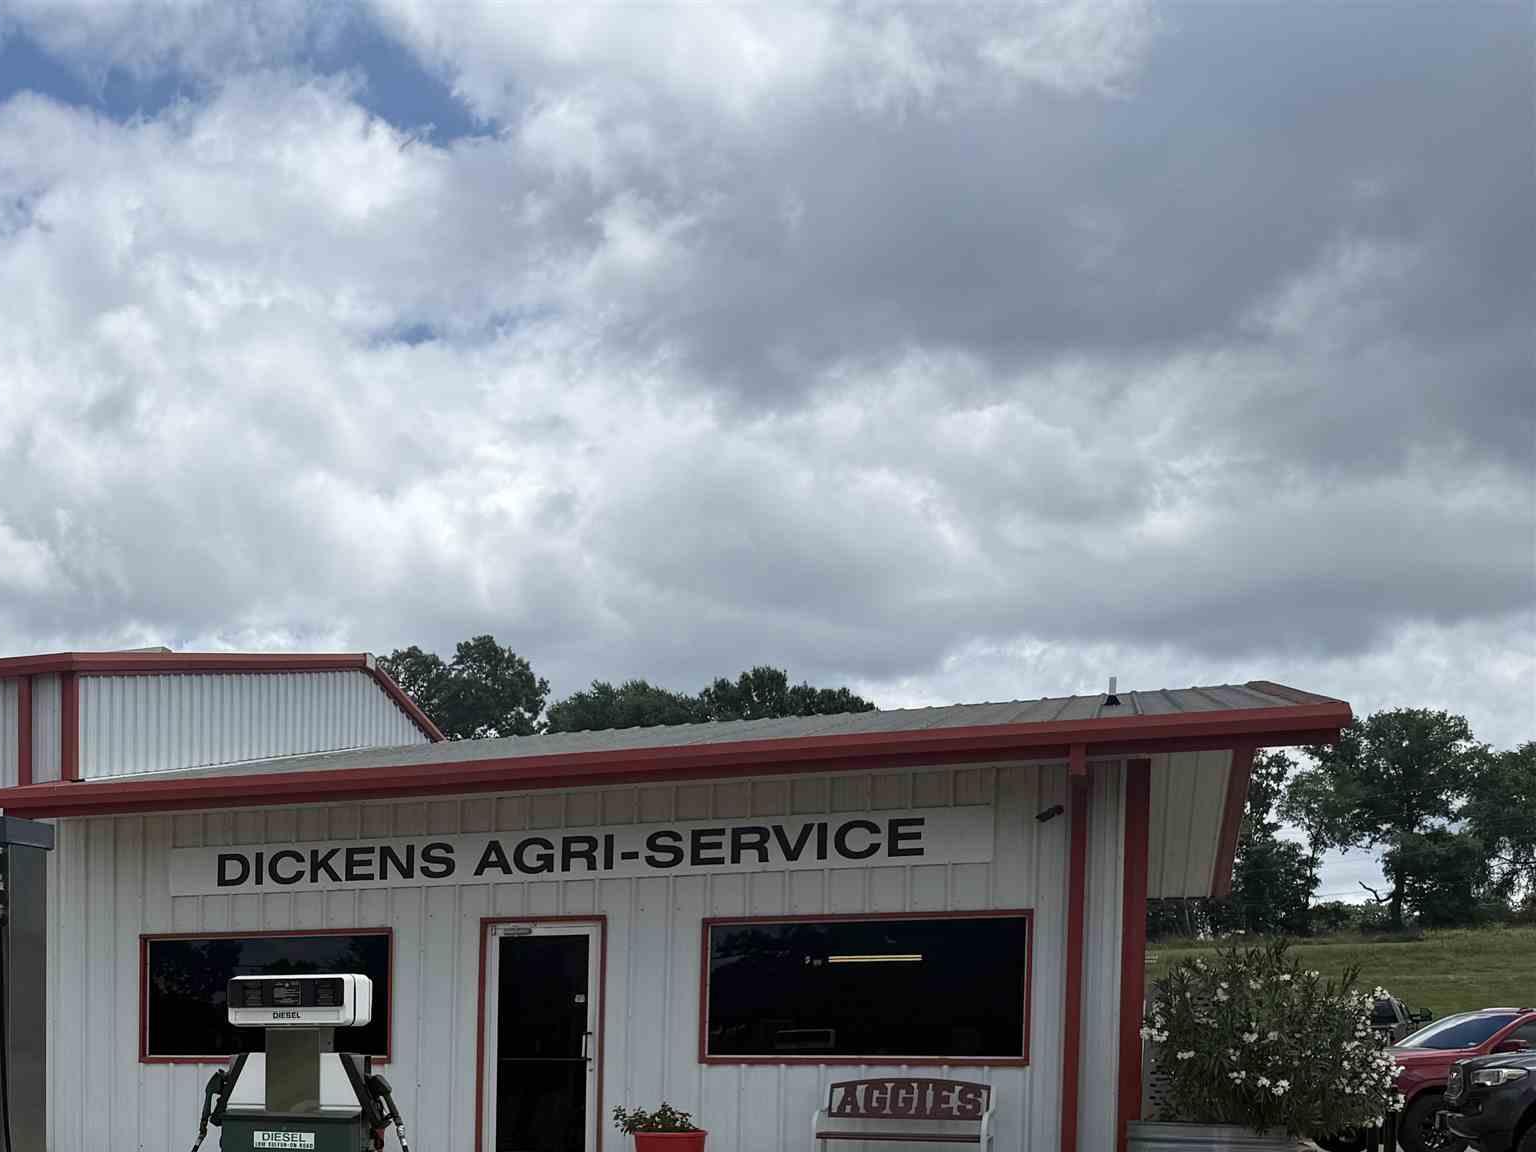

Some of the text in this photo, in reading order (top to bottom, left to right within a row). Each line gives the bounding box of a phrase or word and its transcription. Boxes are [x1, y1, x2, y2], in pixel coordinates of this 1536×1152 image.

[216, 817, 926, 888] DICKENS AGRI-SERVICE
[272, 1011, 301, 1020] DIESEL
[831, 1085, 986, 1114] AGGIES
[262, 1132, 306, 1142] DIESEL
